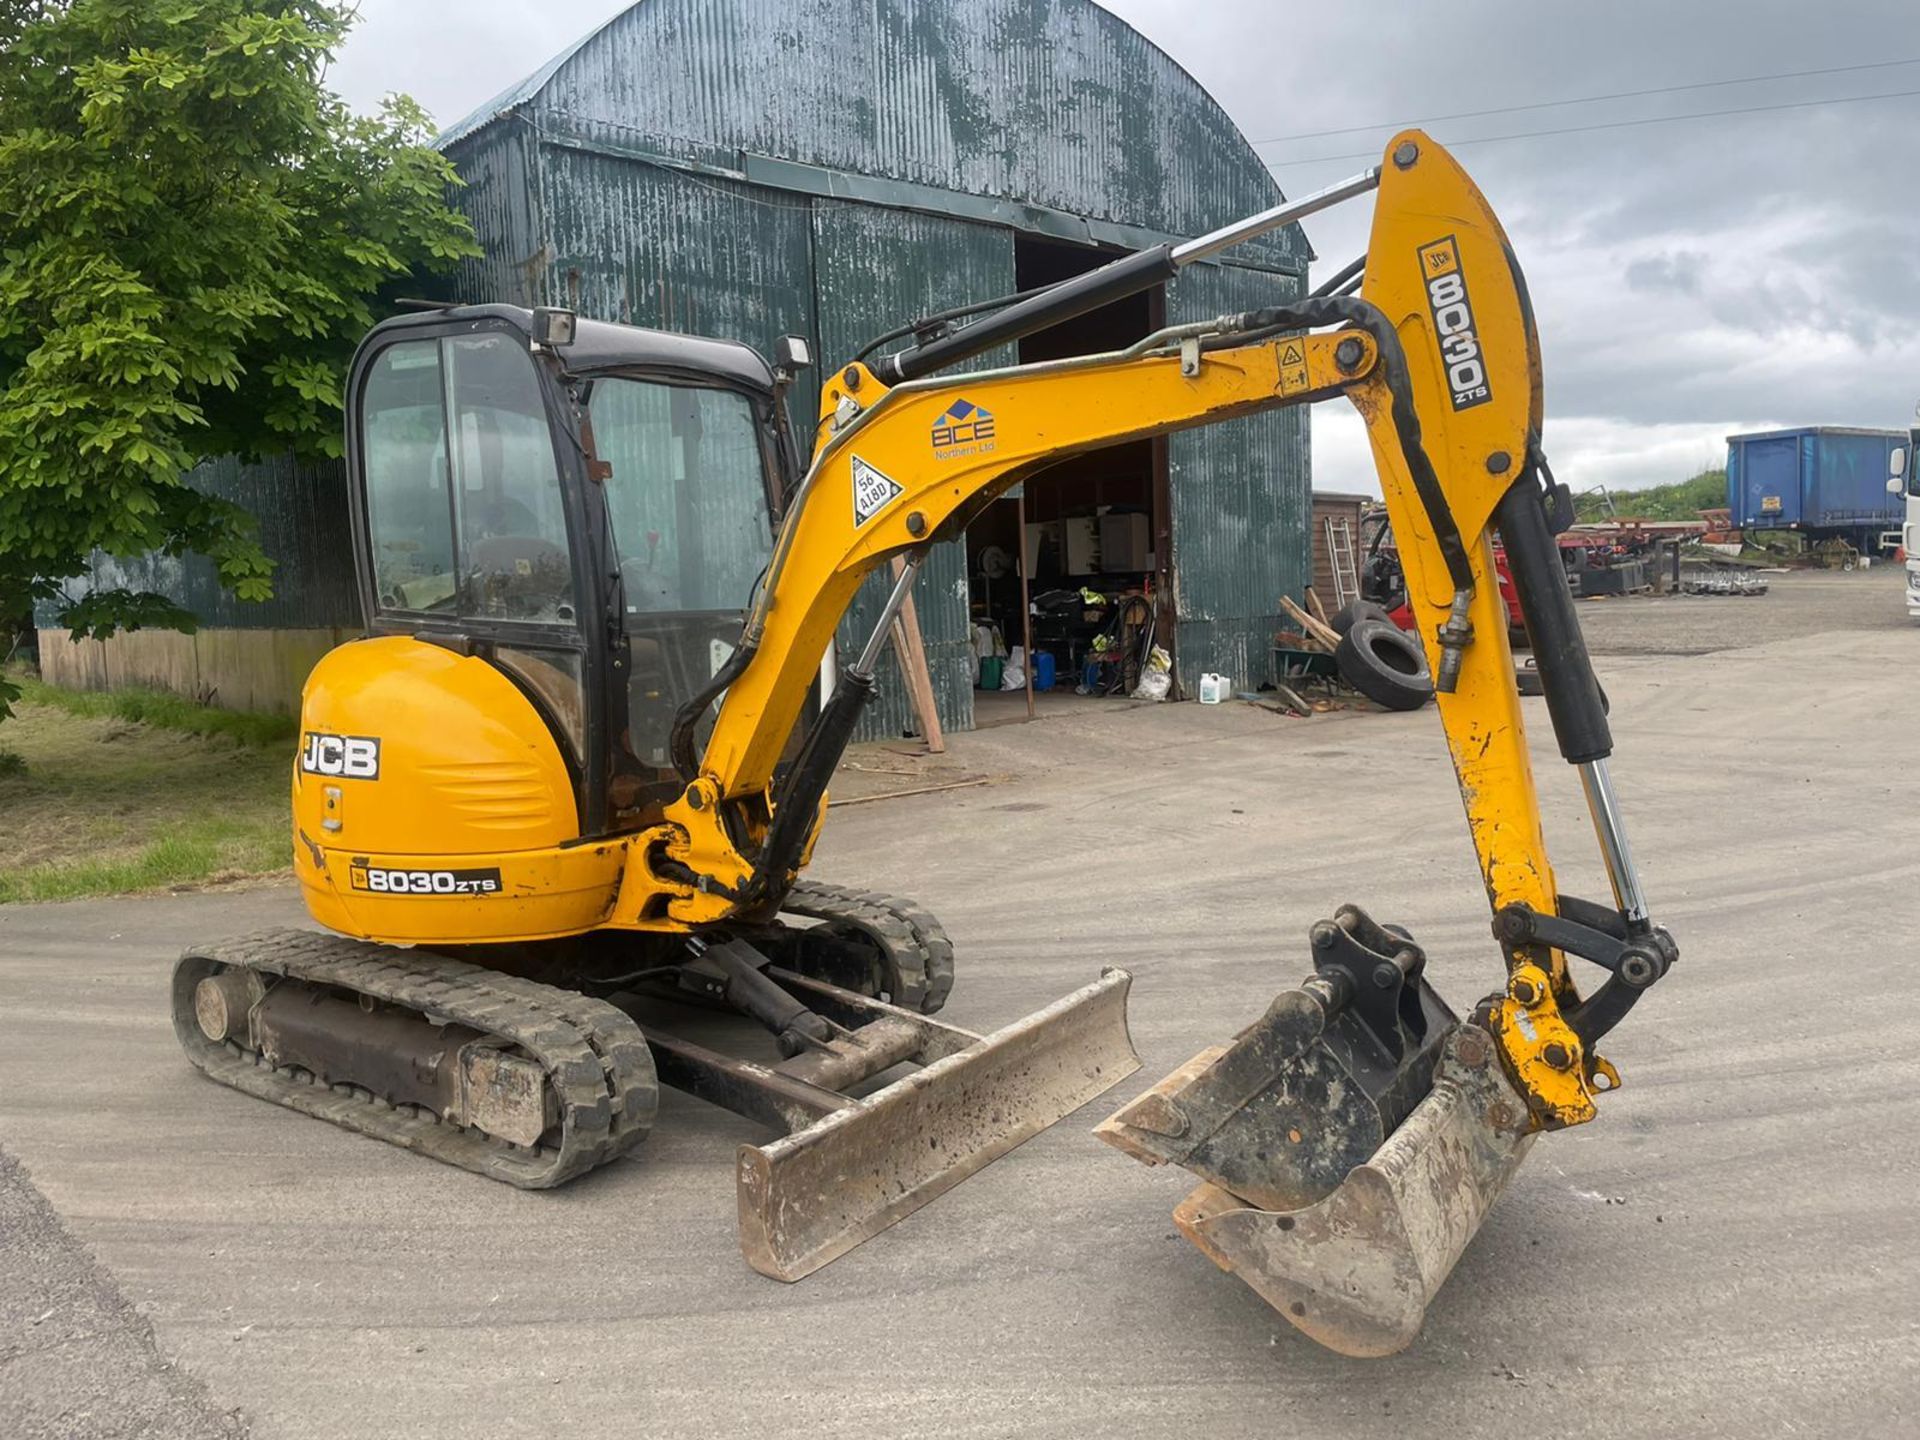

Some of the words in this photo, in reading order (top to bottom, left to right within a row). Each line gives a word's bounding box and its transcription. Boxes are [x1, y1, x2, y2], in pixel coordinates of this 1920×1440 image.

[1429, 273, 1484, 392] 8030
[1455, 386, 1488, 404] ZTS
[935, 446, 977, 460] Northern
[979, 442, 995, 452] Ltd
[858, 473, 875, 492] 56
[303, 734, 377, 776] JCB
[368, 869, 456, 893] 8030
[456, 879, 496, 892] ZTS
